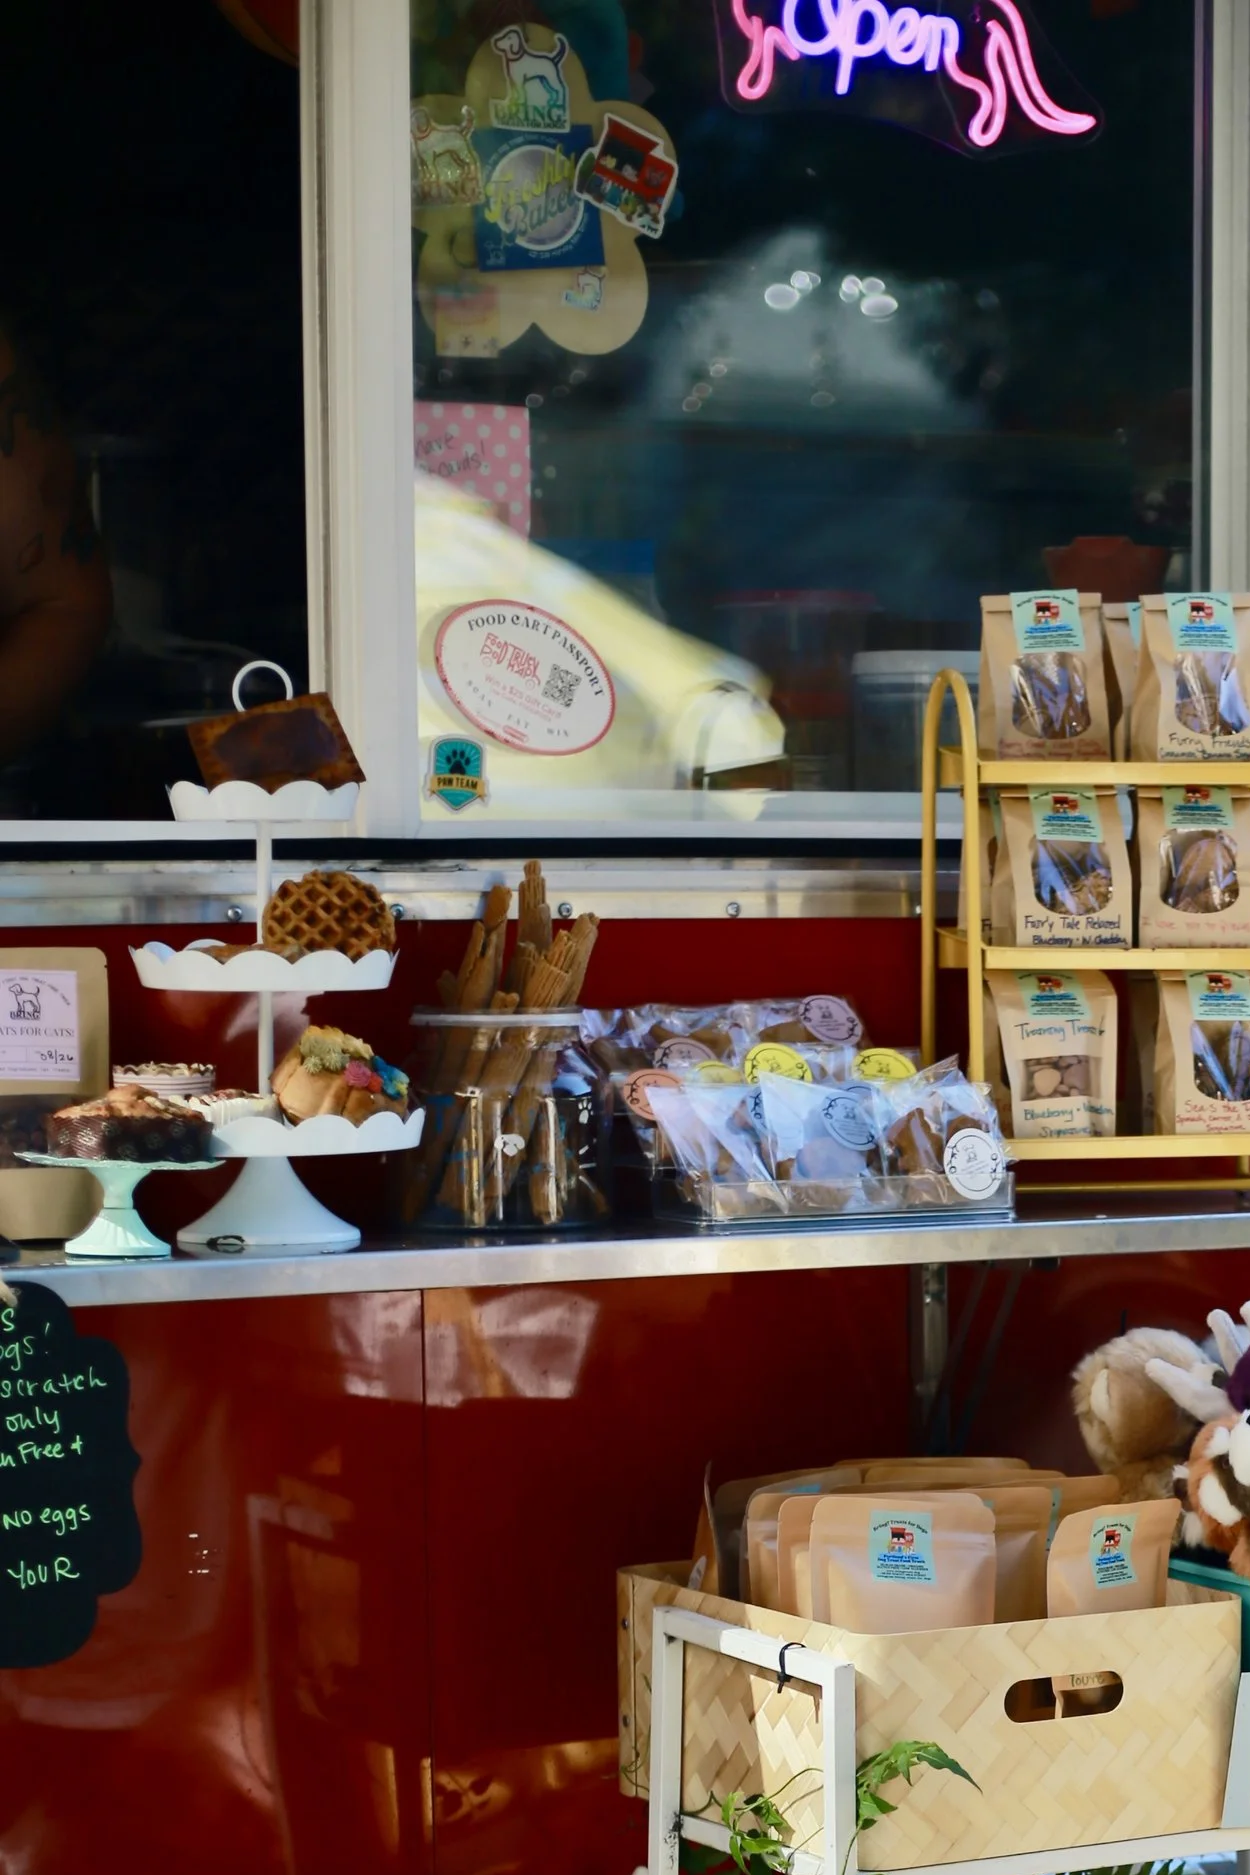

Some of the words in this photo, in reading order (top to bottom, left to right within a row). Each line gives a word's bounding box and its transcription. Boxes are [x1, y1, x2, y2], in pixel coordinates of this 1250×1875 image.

[782, 0, 959, 95] Open
[467, 613, 507, 632] FOOD
[511, 614, 552, 636] CART
[551, 630, 605, 697] PASSPORT
[437, 776, 453, 787] PAW
[455, 777, 478, 790] TEAM
[20, 1027, 42, 1036] FOR
[0, 1365, 107, 1398] scratch
[6, 1406, 61, 1434] only
[18, 1440, 66, 1467] Free
[39, 1503, 92, 1536] eggs
